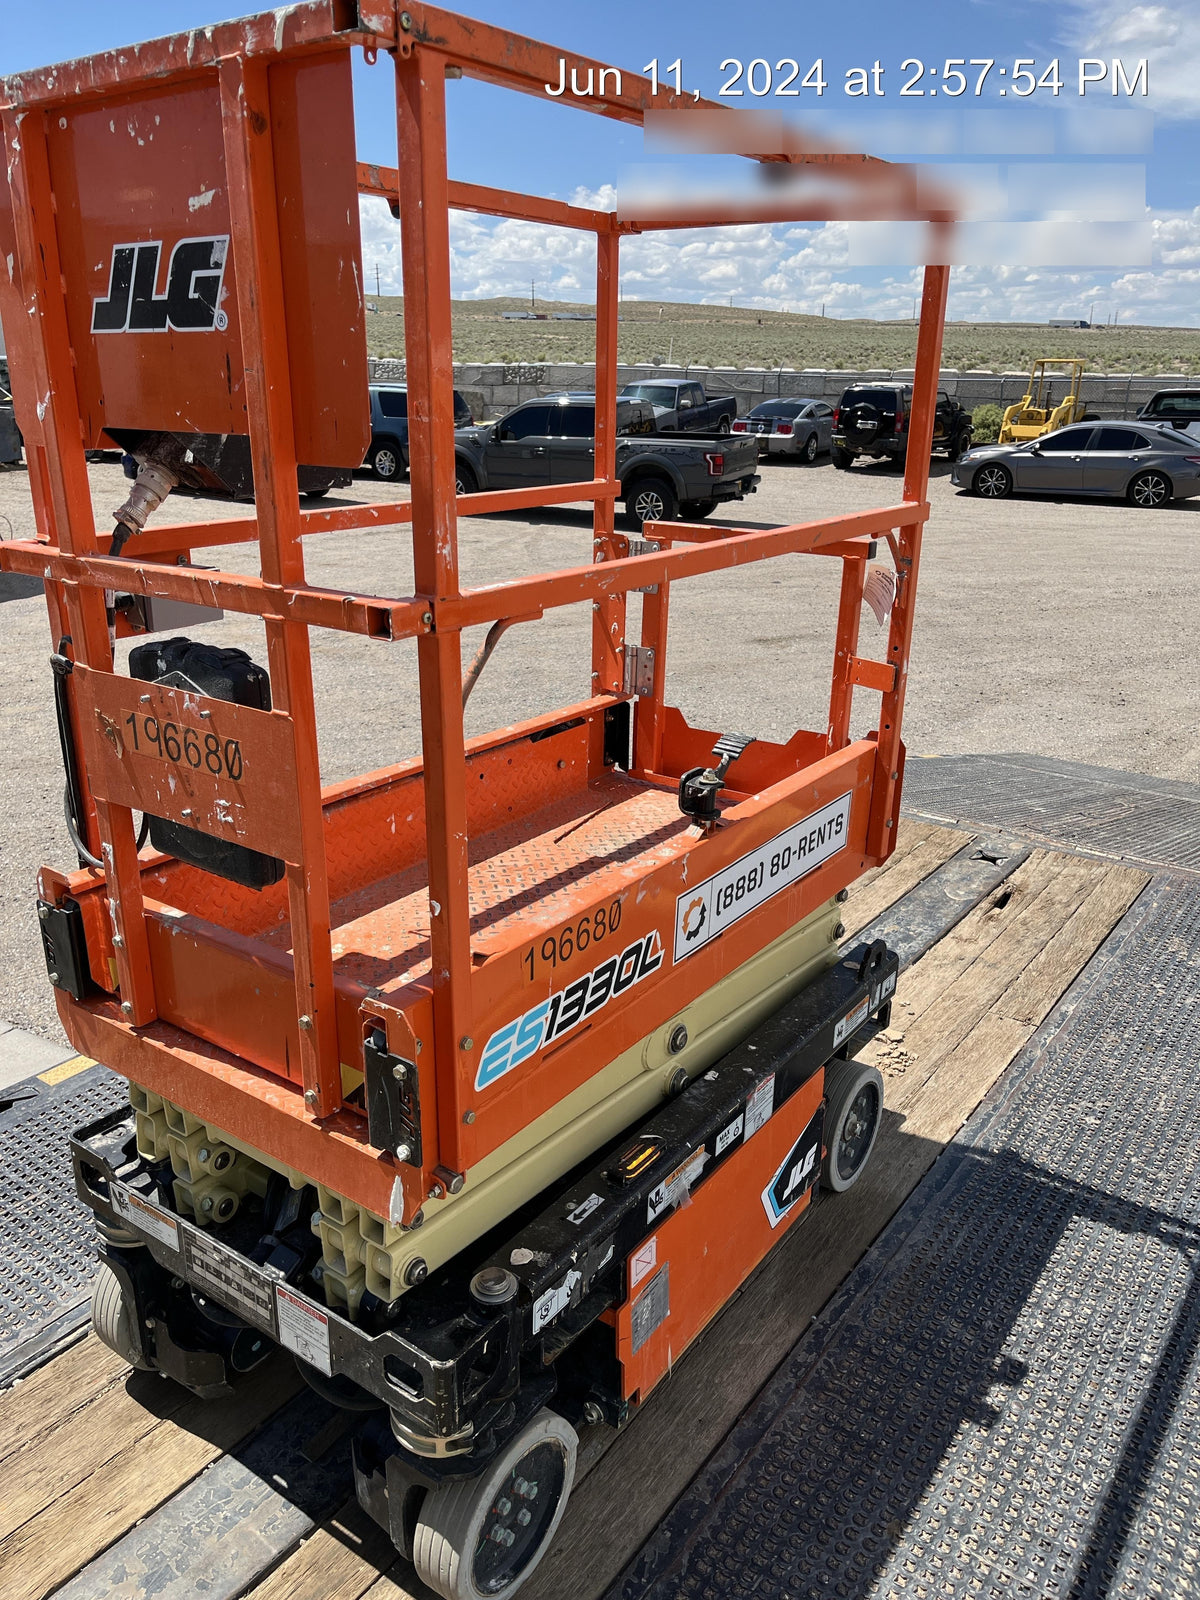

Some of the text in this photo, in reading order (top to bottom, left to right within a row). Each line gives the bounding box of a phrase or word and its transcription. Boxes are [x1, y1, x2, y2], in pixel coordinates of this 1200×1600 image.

[126, 712, 243, 780] 196680
[716, 813, 844, 917] (888) 80-RENTS
[524, 898, 623, 981] 196680
[475, 929, 666, 1091] ES1330L
[782, 1142, 818, 1200] JLG
